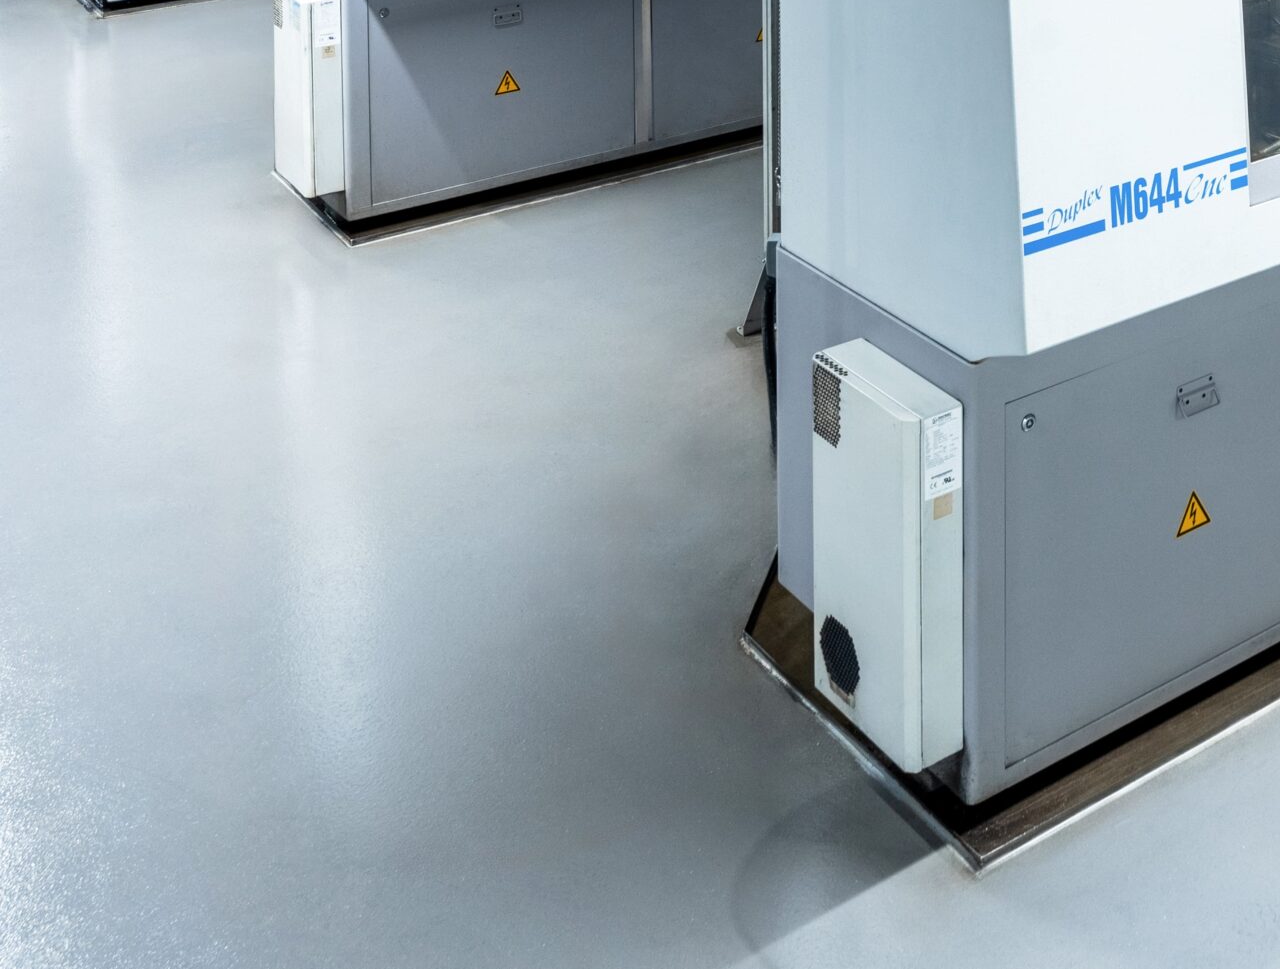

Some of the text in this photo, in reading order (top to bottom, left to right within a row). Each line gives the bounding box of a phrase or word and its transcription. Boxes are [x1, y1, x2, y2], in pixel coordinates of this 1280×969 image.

[1047, 167, 1227, 234] Duplex M644 Cnc
